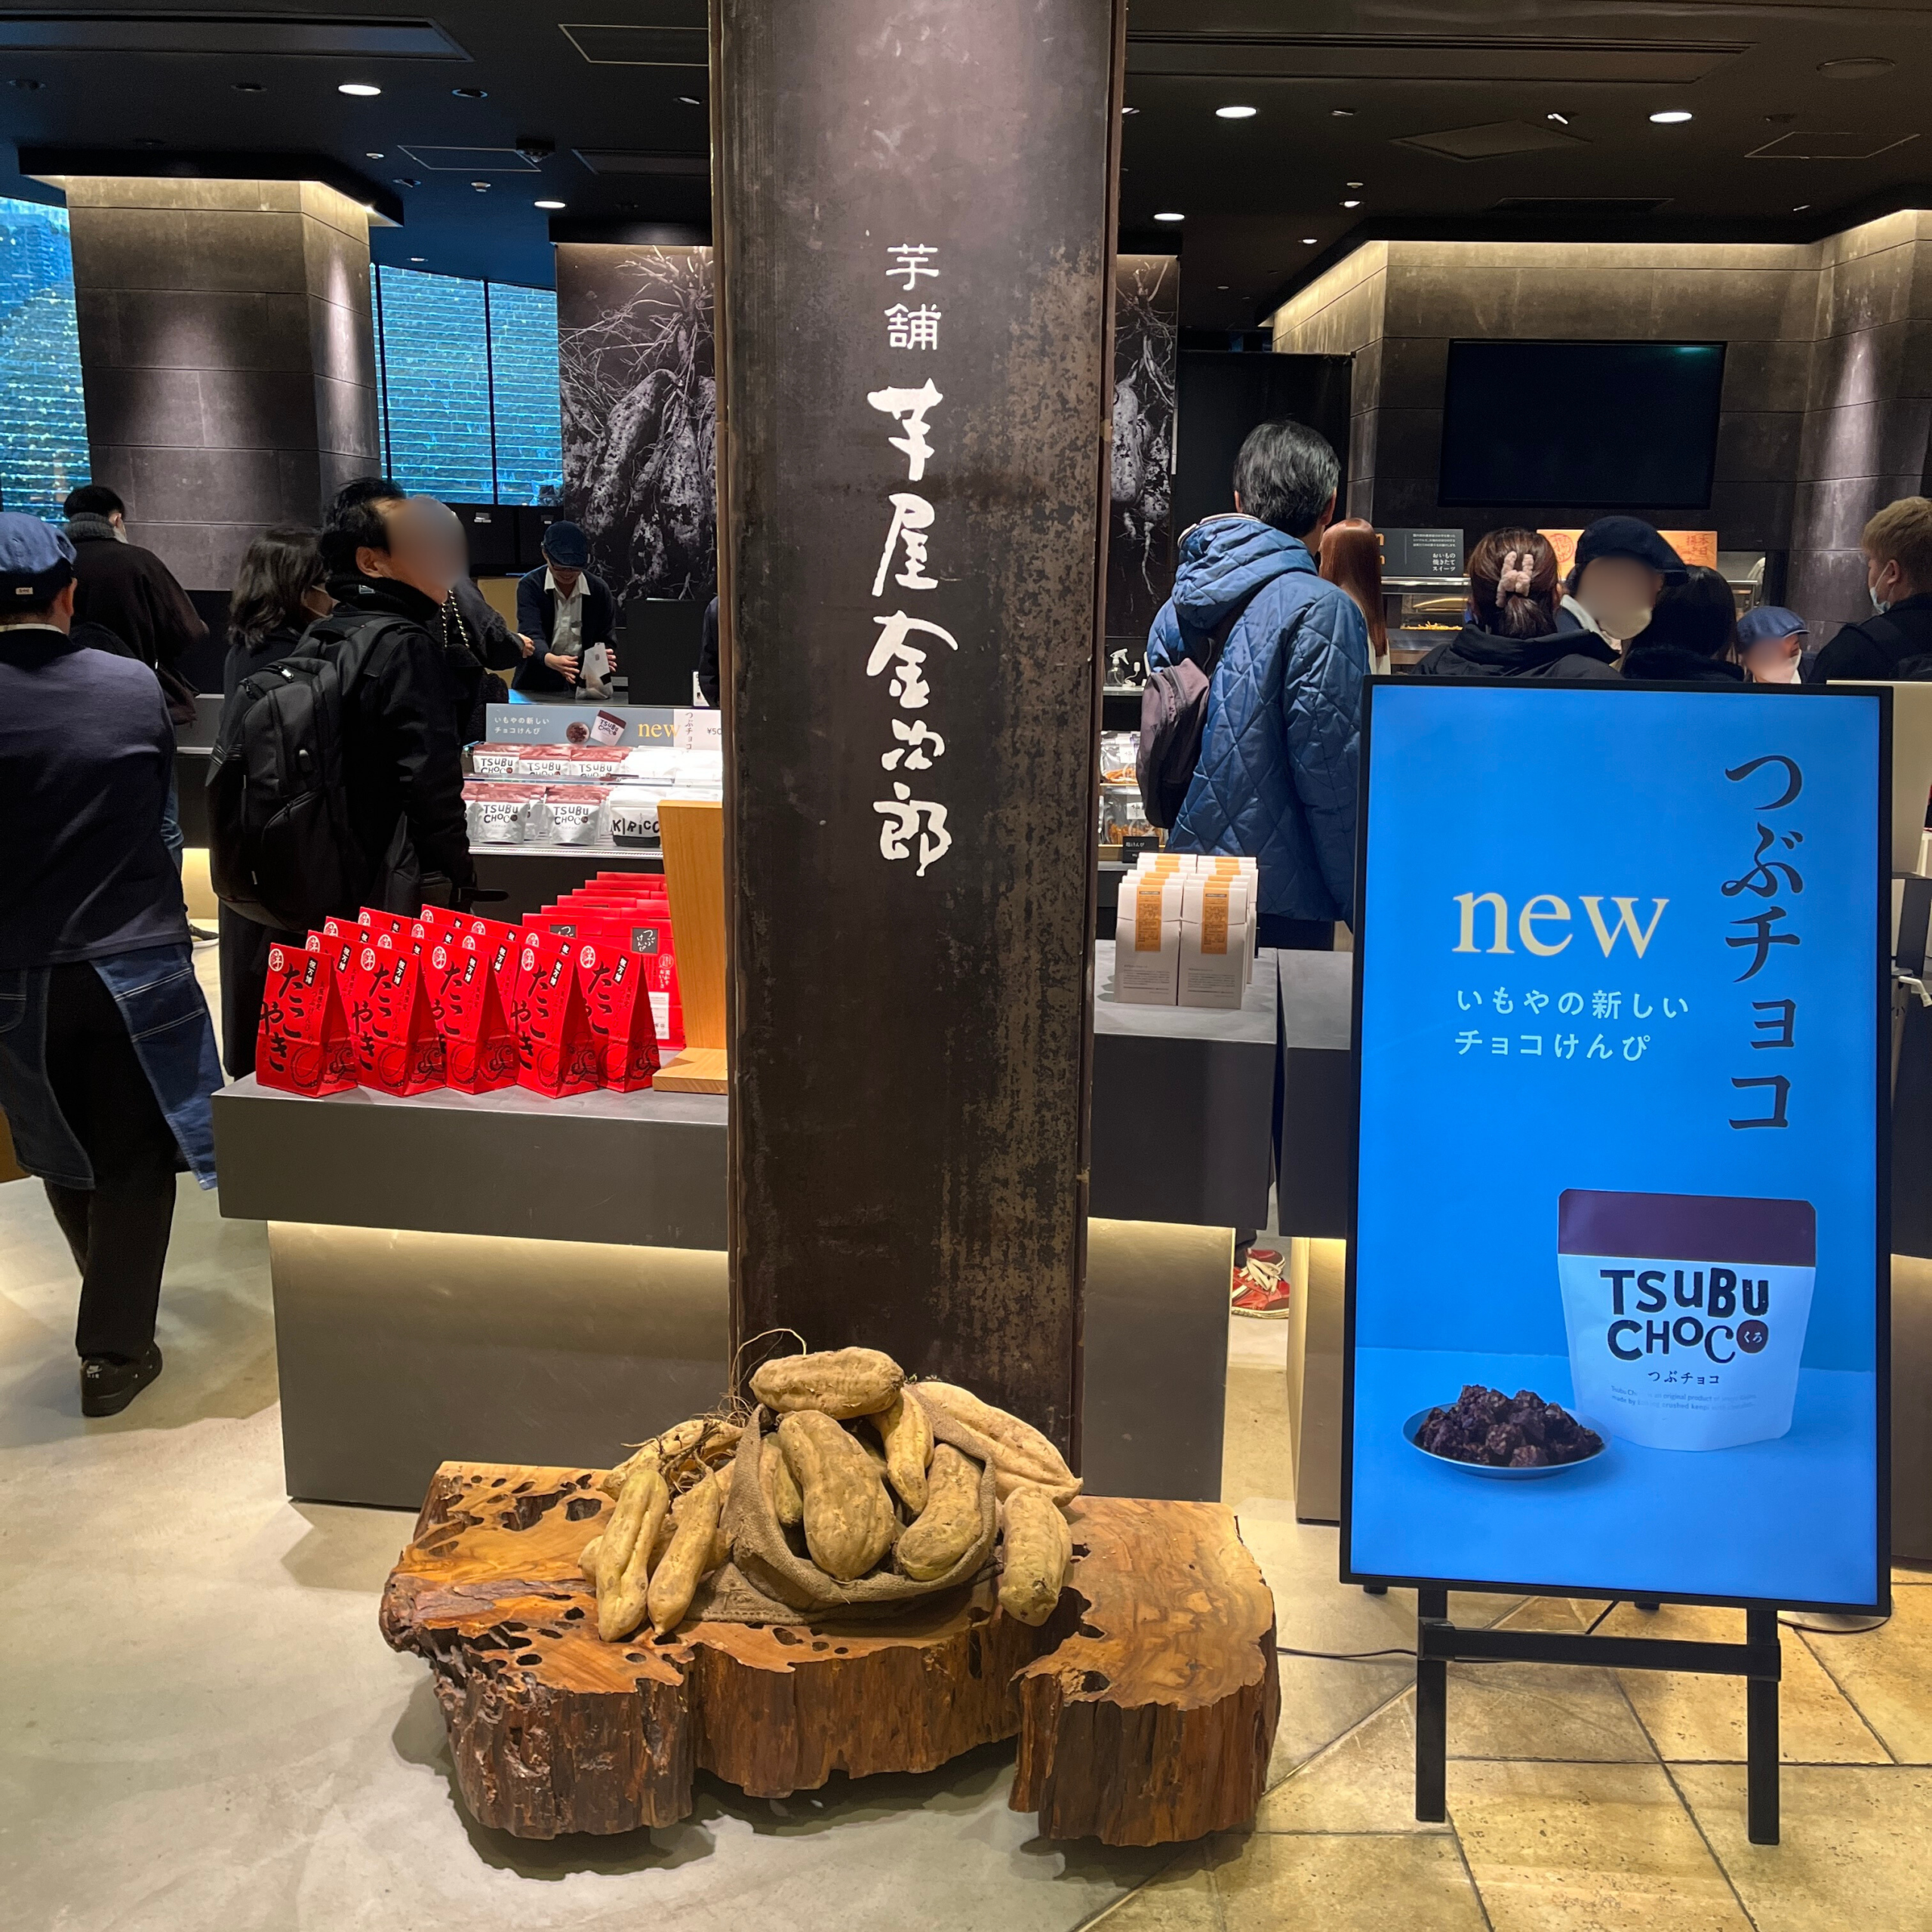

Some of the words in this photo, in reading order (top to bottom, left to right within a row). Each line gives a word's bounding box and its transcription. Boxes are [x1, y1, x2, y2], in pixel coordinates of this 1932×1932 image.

[884, 244, 942, 349] 芋舗
[494, 716, 549, 724] いもやの新しい
[494, 727, 541, 735] チョコけんぴ
[638, 723, 681, 737] new
[685, 712, 694, 749] つぶチョコ
[481, 758, 513, 767] TSUBU
[528, 762, 561, 771] TSUBU
[579, 763, 612, 772] TSUBU
[483, 804, 518, 814] TSUBU
[553, 806, 589, 816] TSUBU
[1452, 891, 1669, 958] new
[1721, 755, 1804, 1130] つぶチョコ
[1457, 986, 1689, 1020] いもやの新しい
[1454, 1029, 1651, 1061] チョコけんぴ
[1600, 1268, 1769, 1318] TSUBU
[1743, 1331, 1763, 1343] くろ
[1647, 1371, 1719, 1385] つぶチョコ
[1663, 1393, 1687, 1401] original
